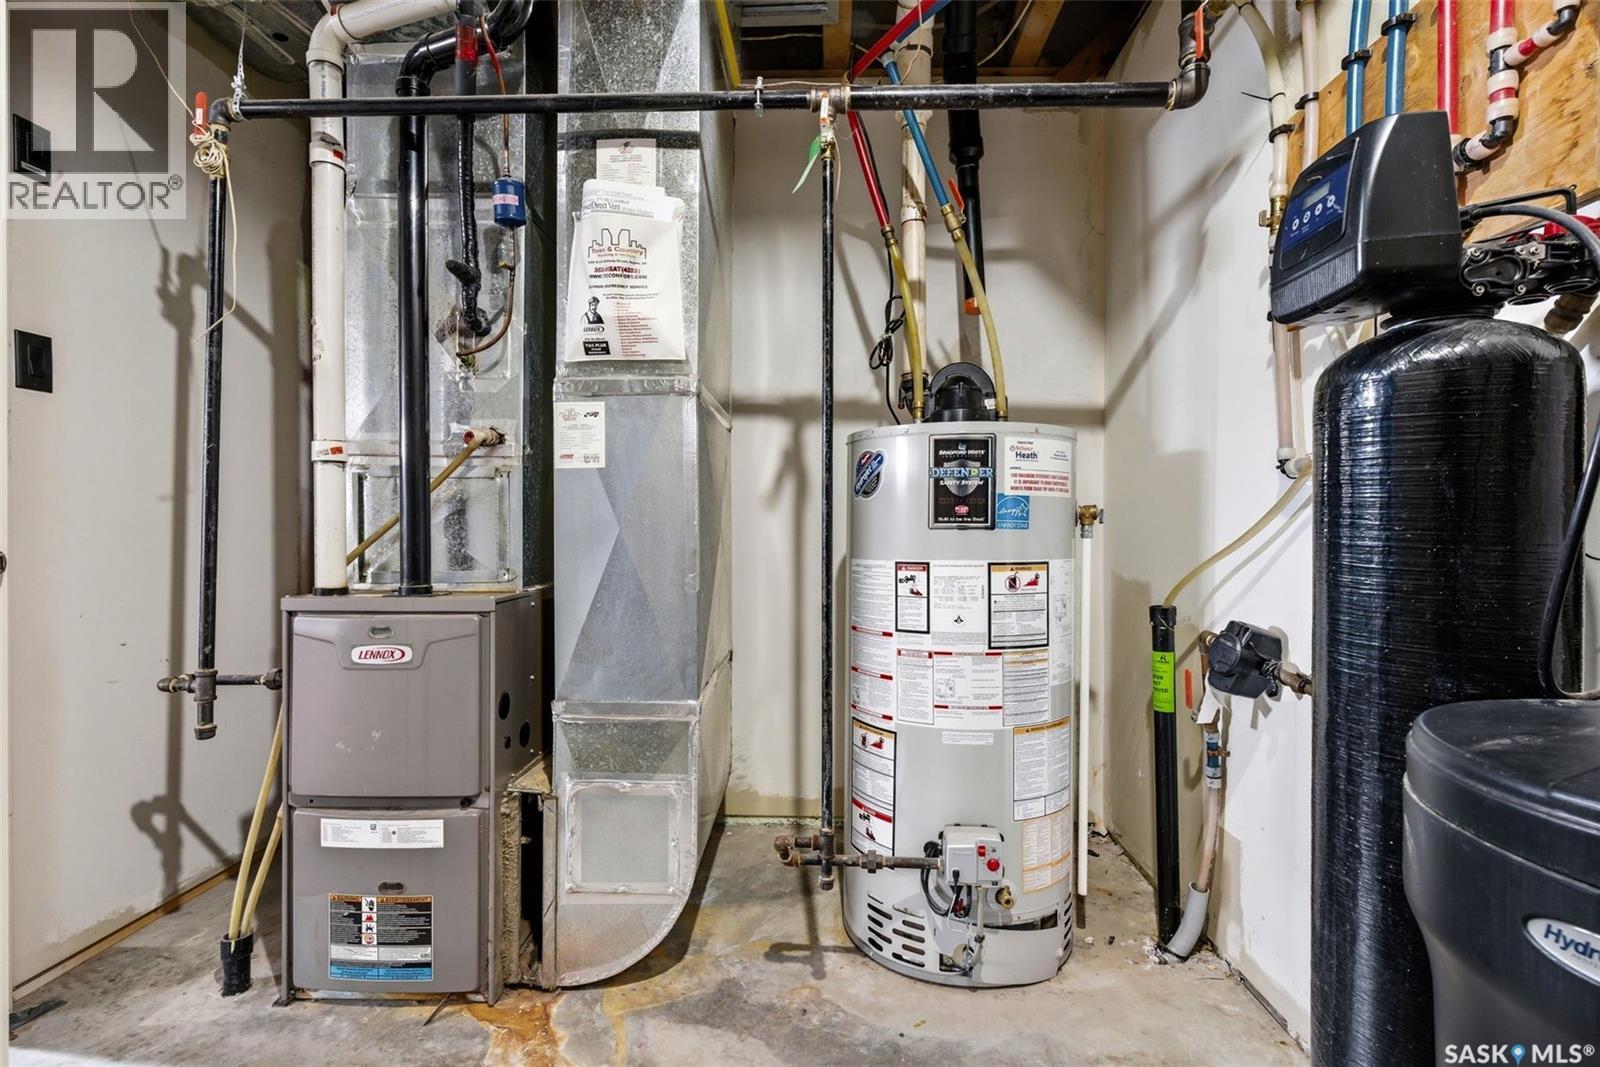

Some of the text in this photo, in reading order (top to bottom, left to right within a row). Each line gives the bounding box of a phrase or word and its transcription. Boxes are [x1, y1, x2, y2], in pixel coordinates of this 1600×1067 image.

[1015, 451, 1038, 460] Heath
[932, 468, 993, 479] DEFENDER
[358, 650, 396, 660] LENNOX
